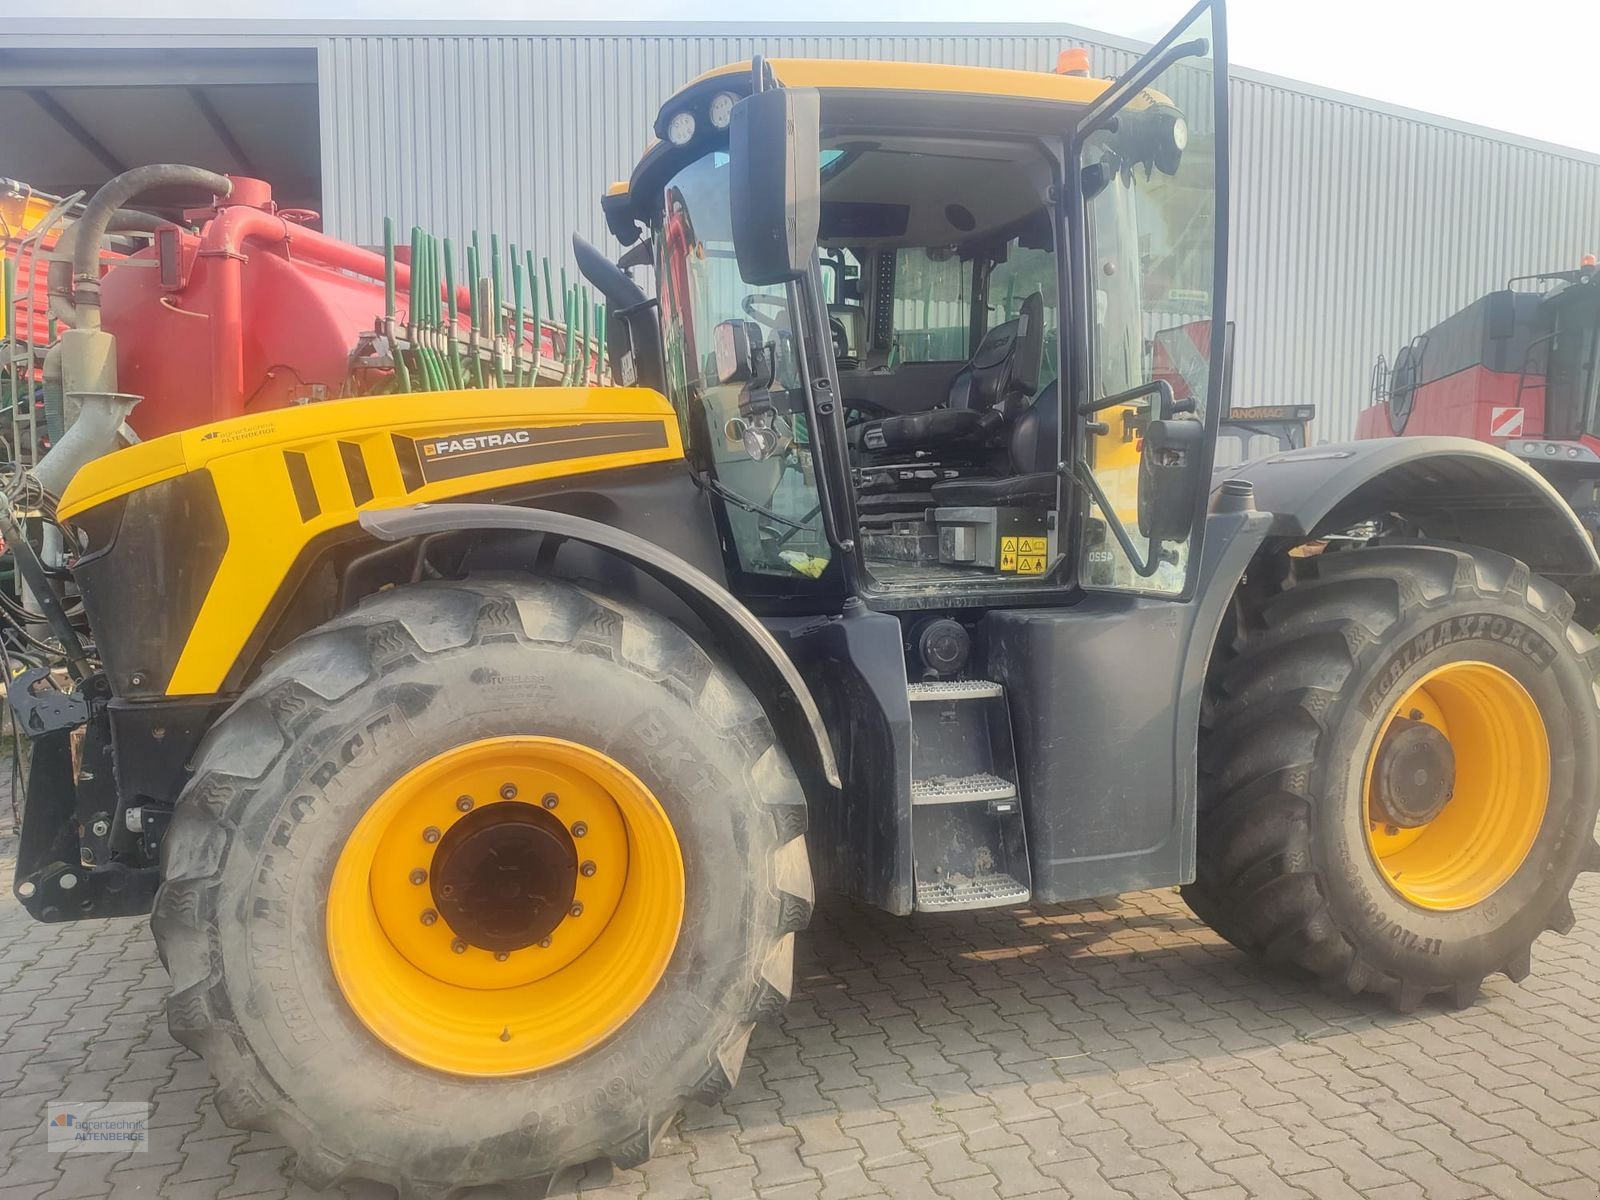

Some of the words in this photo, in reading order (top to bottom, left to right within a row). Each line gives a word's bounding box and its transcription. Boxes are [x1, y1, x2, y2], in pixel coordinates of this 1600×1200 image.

[1230, 407, 1281, 419] ANOMAG
[435, 431, 530, 454] FASTRAC
[634, 710, 720, 797] BKT
